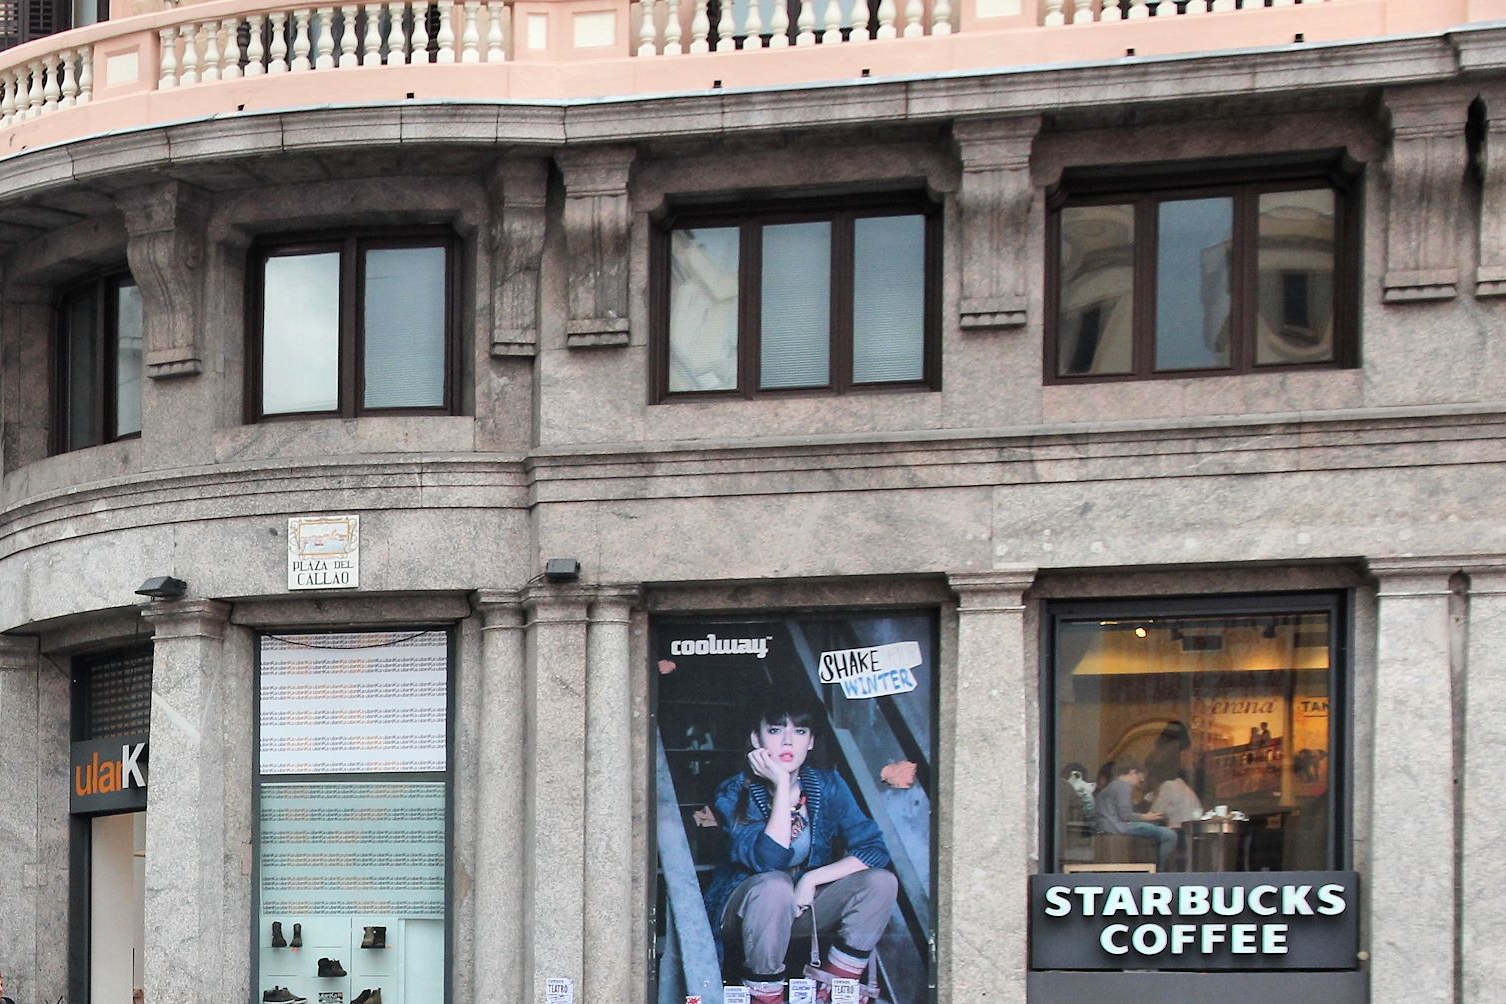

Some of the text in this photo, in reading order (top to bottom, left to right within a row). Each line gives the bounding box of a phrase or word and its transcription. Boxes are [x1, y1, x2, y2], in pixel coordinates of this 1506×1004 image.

[292, 560, 354, 572] PLAZA DEL
[297, 571, 350, 586] CALLAO
[671, 634, 769, 659] coolway
[820, 650, 882, 682] SHAKE
[844, 668, 915, 696] WINTER
[1044, 883, 1347, 917] STARBUCKS
[1099, 923, 1289, 956] COFFEE
[834, 985, 854, 994] TEATRO
